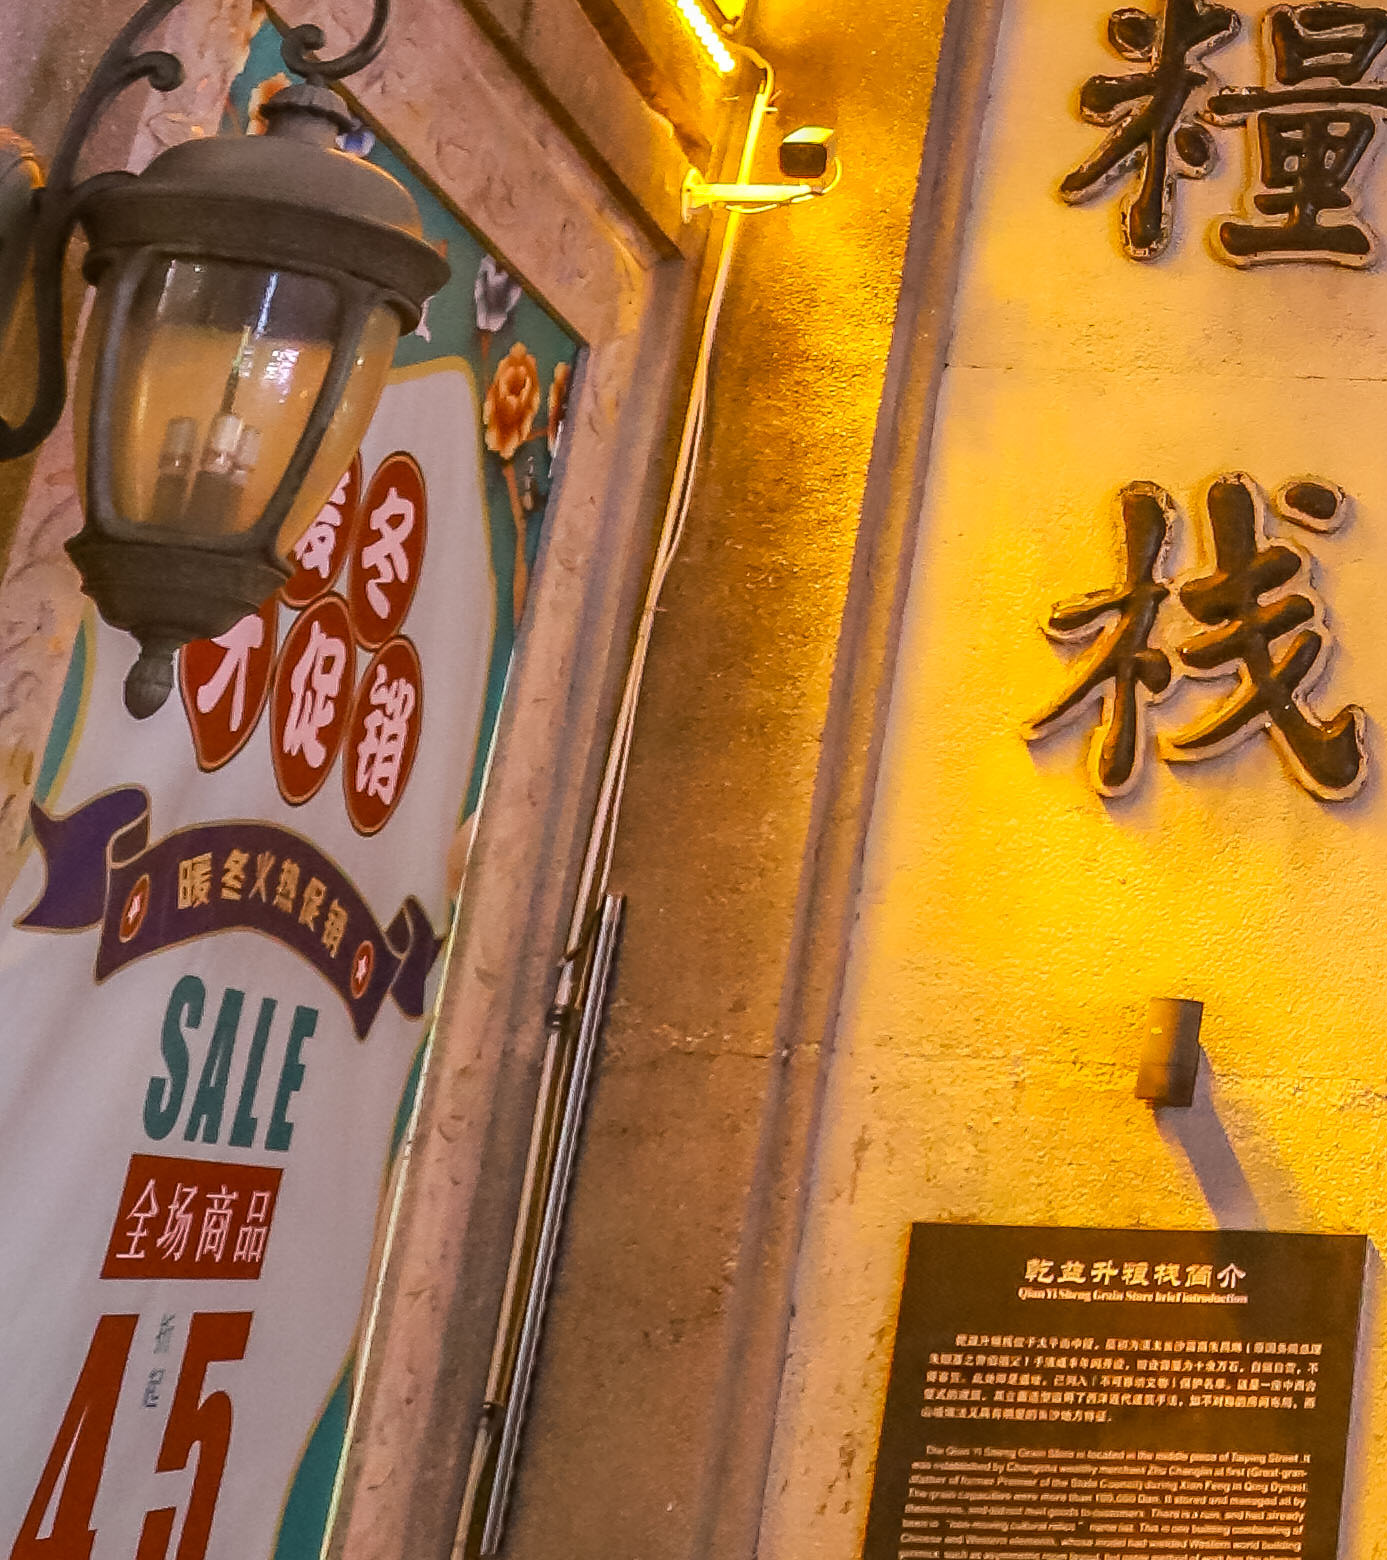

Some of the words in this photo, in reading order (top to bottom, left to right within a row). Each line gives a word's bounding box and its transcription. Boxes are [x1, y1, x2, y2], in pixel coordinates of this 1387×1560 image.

[143, 975, 320, 1152] SALE
[115, 1178, 271, 1264] 全场商品
